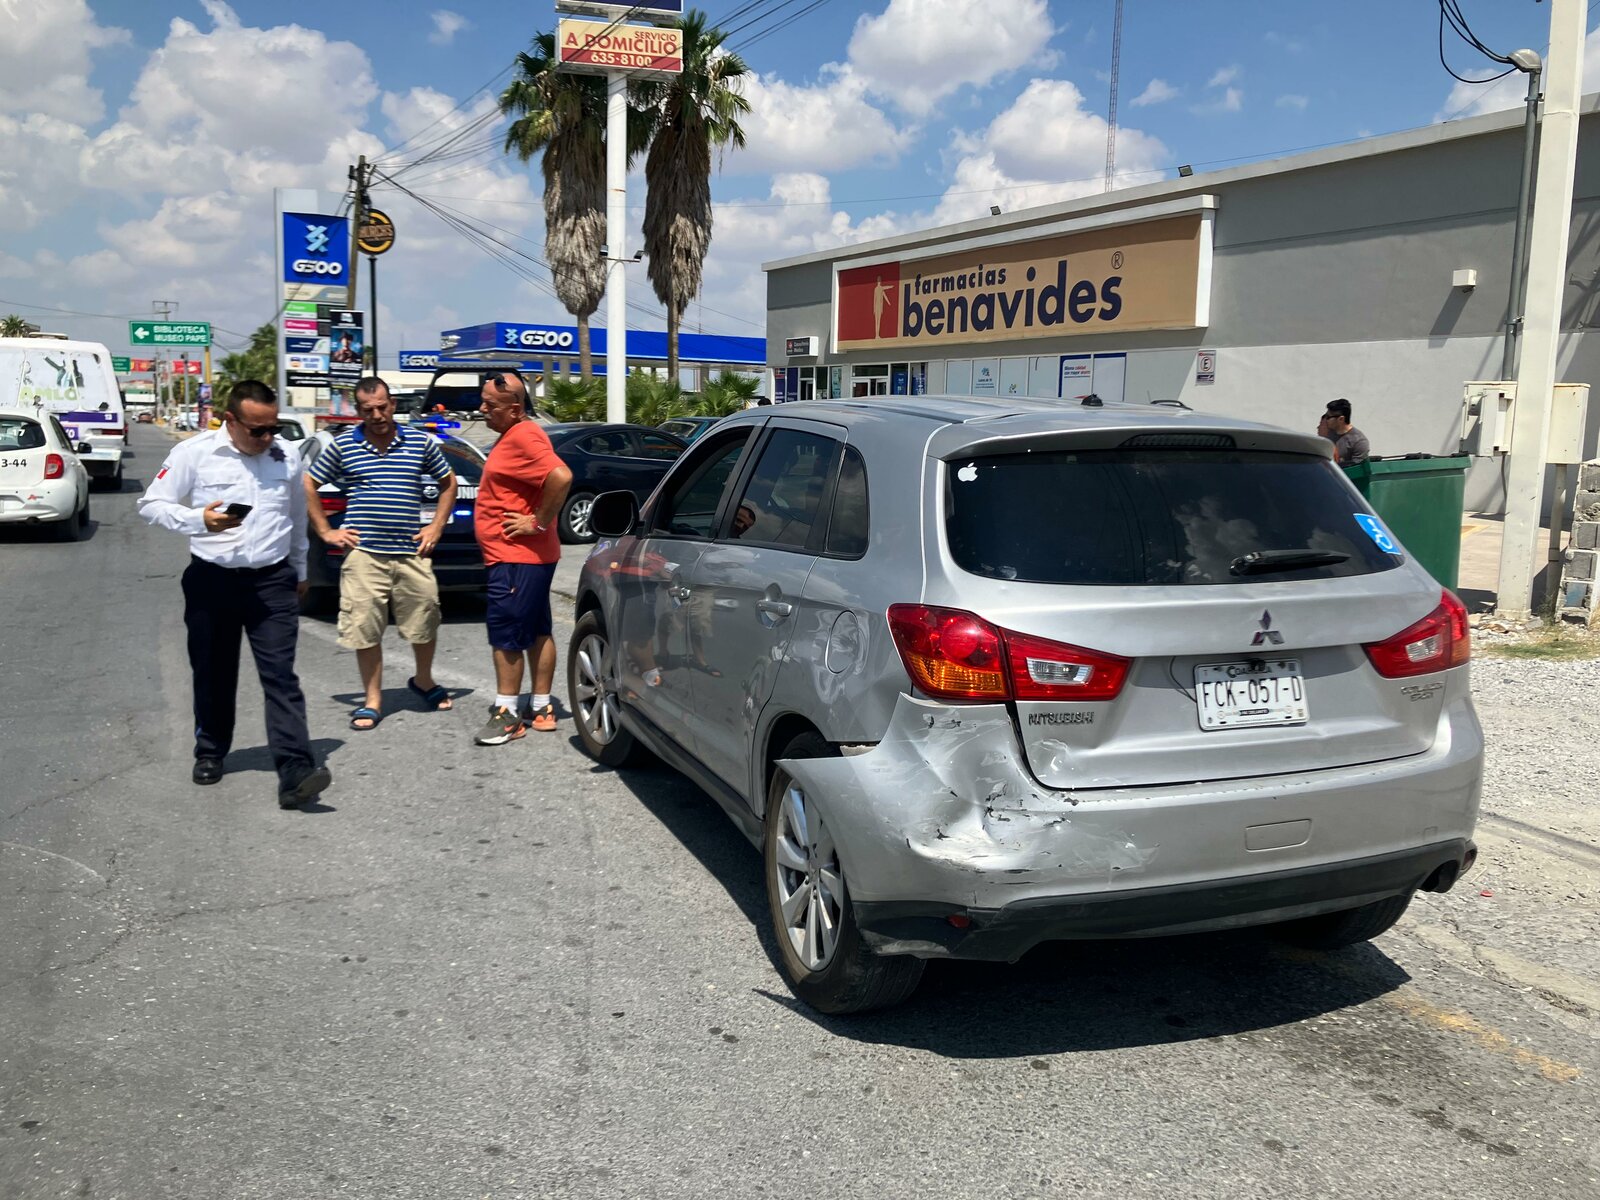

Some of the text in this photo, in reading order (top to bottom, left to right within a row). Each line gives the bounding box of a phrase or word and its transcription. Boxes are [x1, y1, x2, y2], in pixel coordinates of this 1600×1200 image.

[566, 32, 677, 55] A DOMICILIO
[634, 31, 677, 41] SERVICIO
[293, 259, 342, 275] G500
[915, 264, 1006, 295] farmacias
[902, 260, 1123, 337] benavides
[153, 325, 206, 334] BIBLIOTECA
[154, 334, 208, 343] MUSEO PAPE
[520, 330, 573, 347] G500
[1, 458, 28, 468] 3-44
[1202, 675, 1303, 709] FCK-057-D
[1028, 711, 1095, 726] MITSUBISHI
